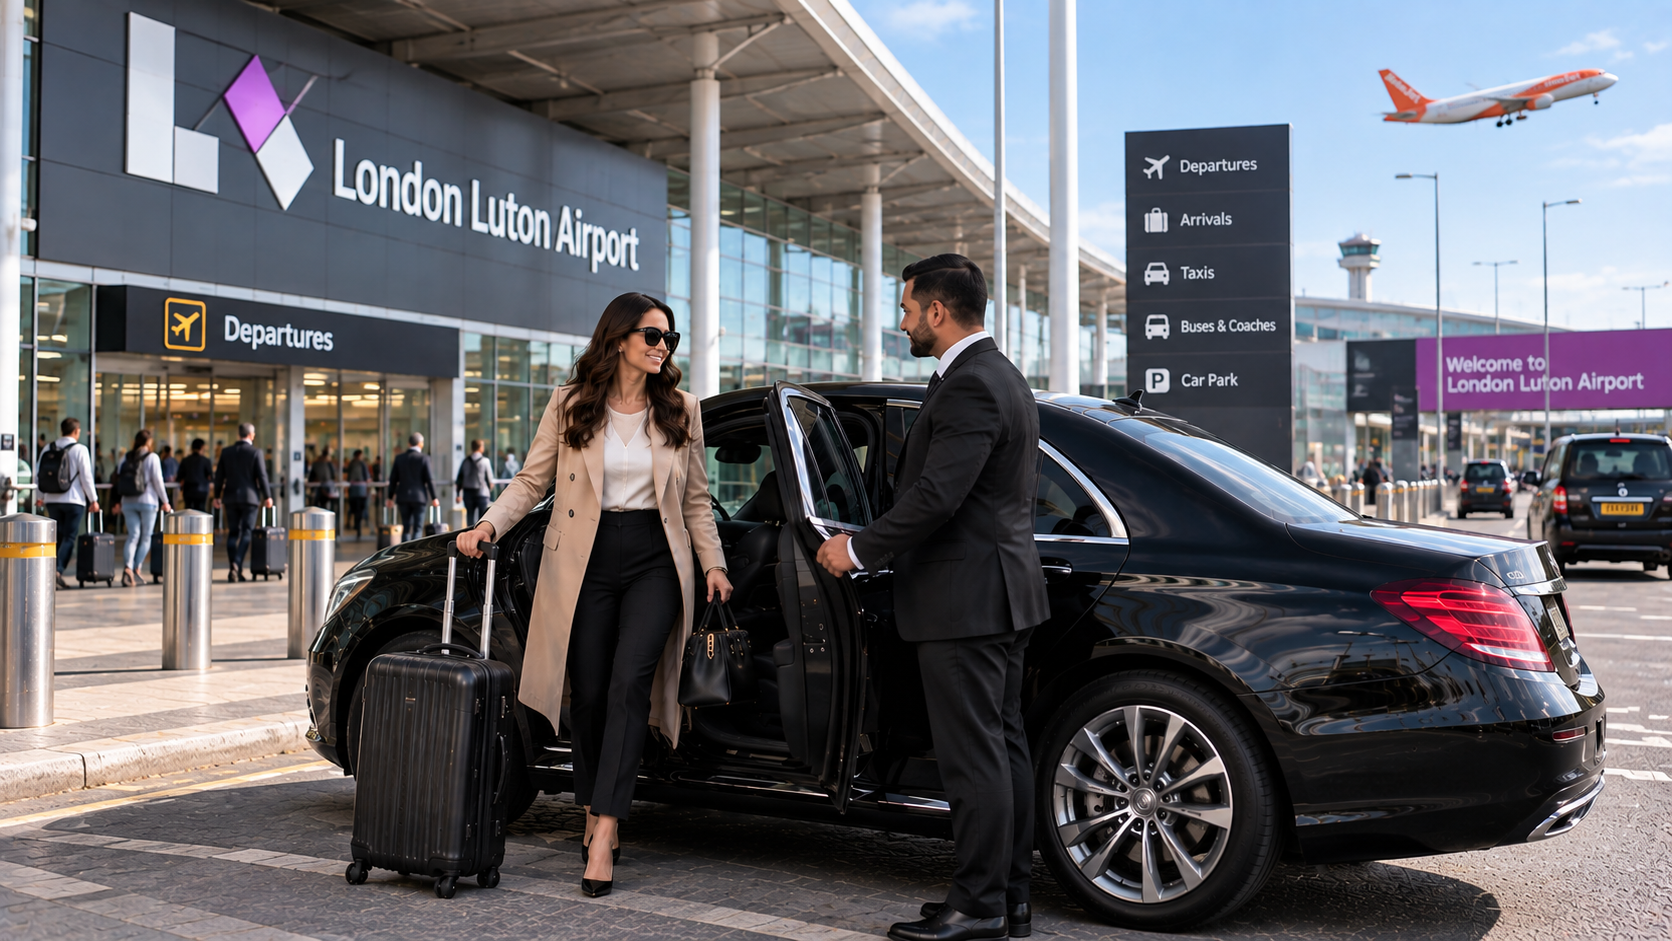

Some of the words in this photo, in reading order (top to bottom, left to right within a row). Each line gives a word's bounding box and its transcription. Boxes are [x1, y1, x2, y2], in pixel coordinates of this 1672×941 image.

[1180, 159, 1257, 175] Departures
[334, 138, 462, 227] London
[471, 179, 550, 250] Luton
[555, 205, 639, 273] Airport
[1180, 212, 1232, 226] Arrivals
[1180, 266, 1215, 279] Taxis
[224, 315, 334, 351] Departures
[1181, 320, 1215, 333] Buses
[1217, 320, 1226, 332] &
[1228, 319, 1276, 332] Coaches
[1446, 355, 1523, 373] Welcome
[1527, 355, 1546, 371] to
[1152, 373, 1164, 388] P
[1181, 374, 1205, 387] Car
[1208, 373, 1238, 386] Park
[1447, 374, 1514, 393] London
[1577, 372, 1644, 394] Airport
